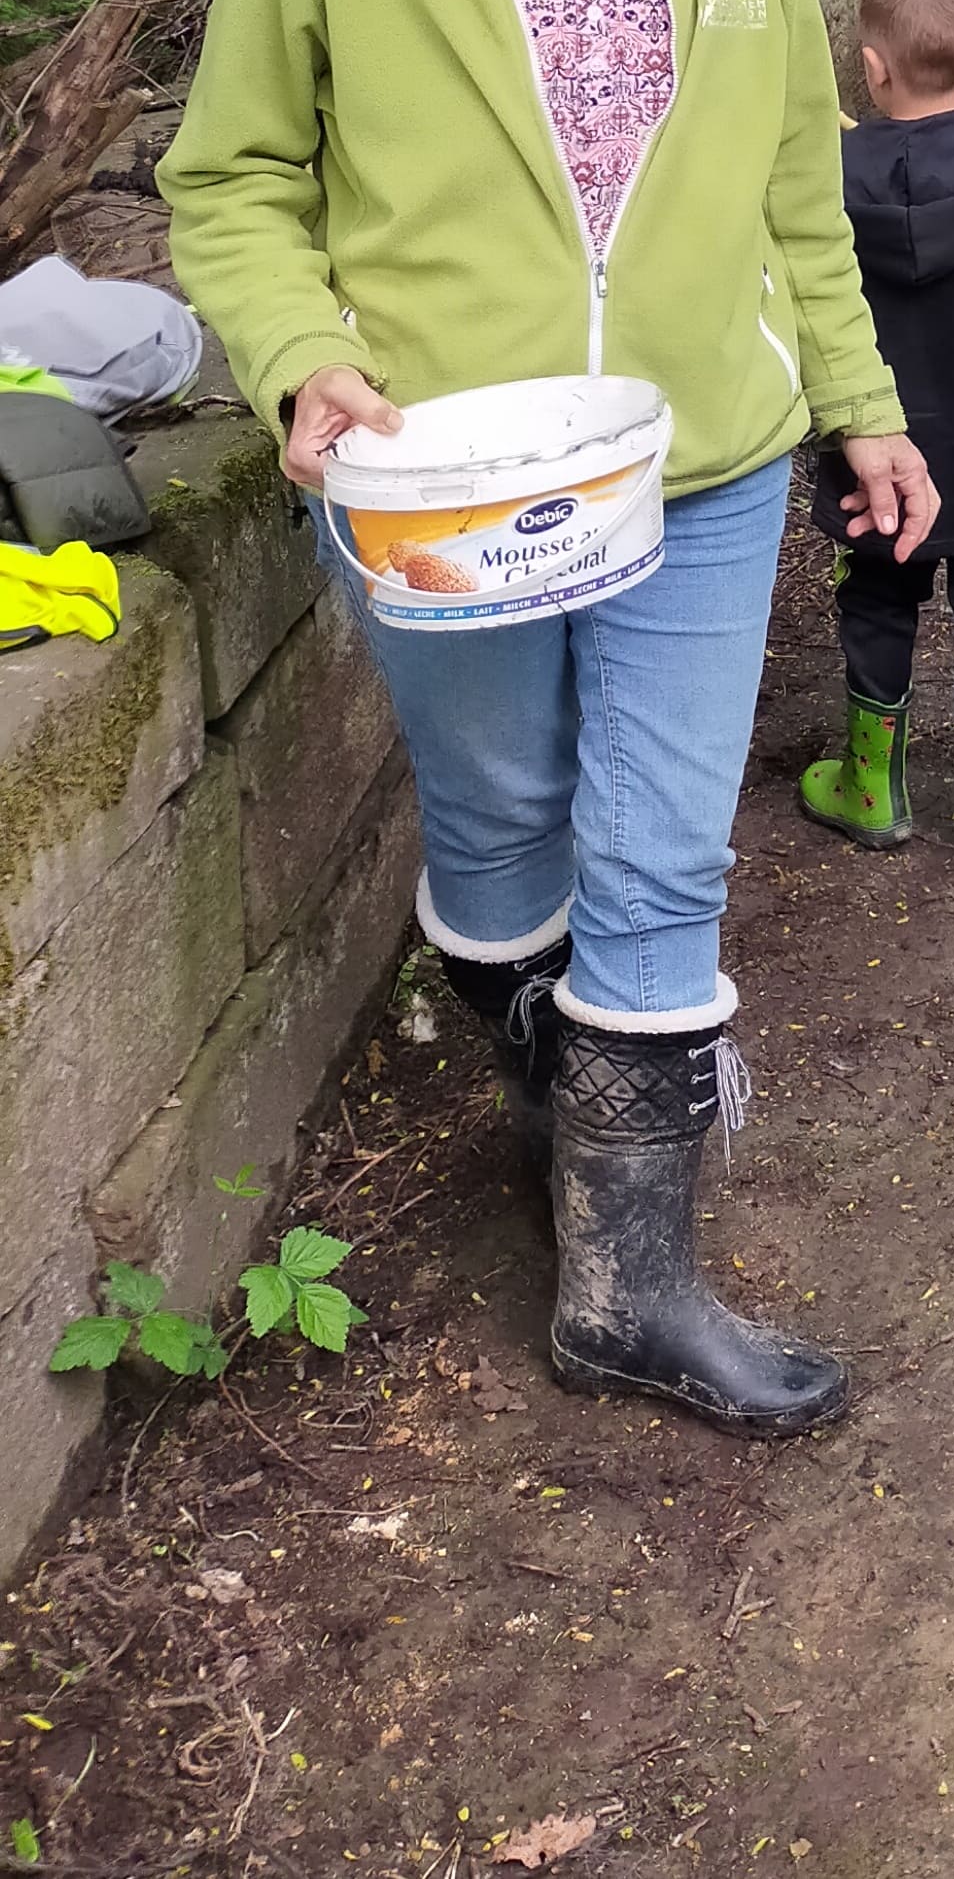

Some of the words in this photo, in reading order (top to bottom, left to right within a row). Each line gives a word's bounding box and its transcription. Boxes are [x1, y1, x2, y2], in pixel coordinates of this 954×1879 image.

[521, 504, 570, 529] Debic
[480, 536, 574, 569] Mousse
[474, 606, 494, 615] LAIT
